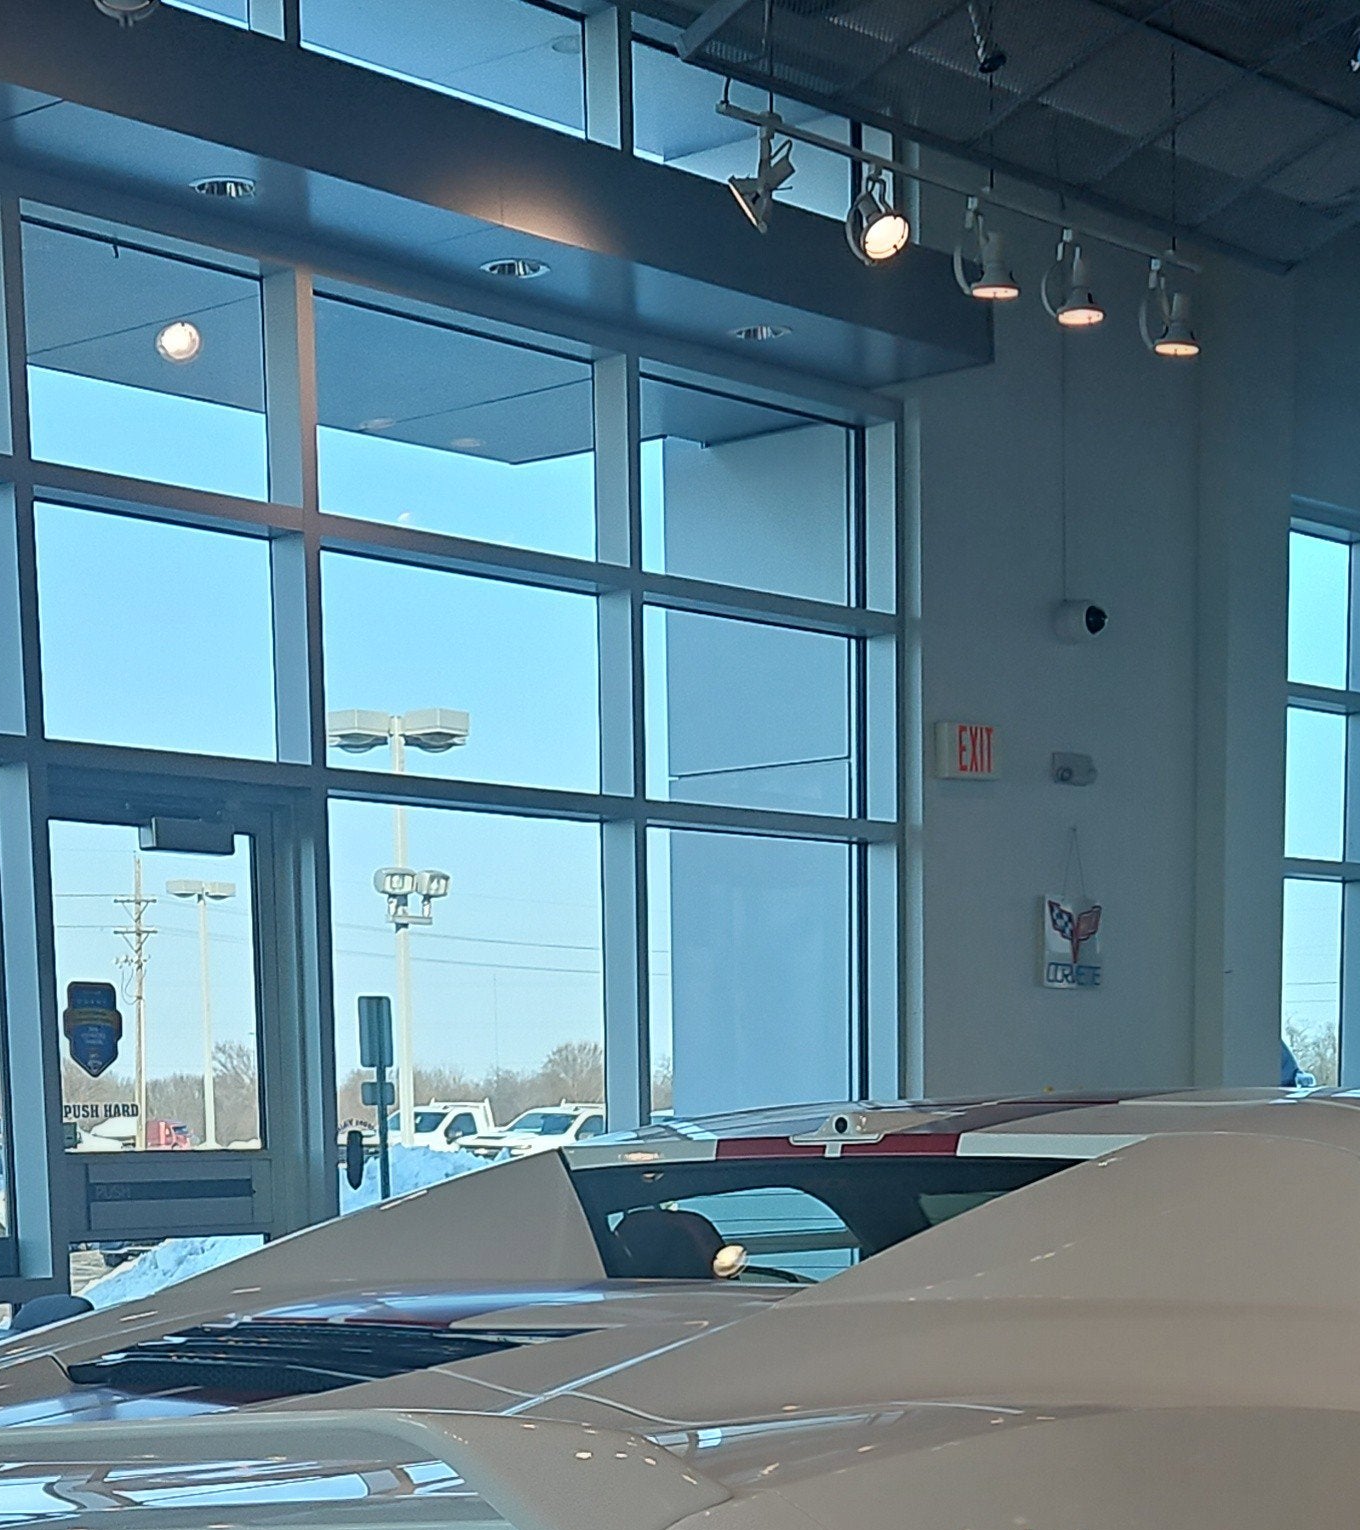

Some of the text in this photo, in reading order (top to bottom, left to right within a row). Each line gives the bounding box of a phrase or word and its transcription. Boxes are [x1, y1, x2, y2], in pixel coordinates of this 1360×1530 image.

[958, 725, 993, 773] EXIT
[63, 1103, 139, 1119] PUSH HARD
